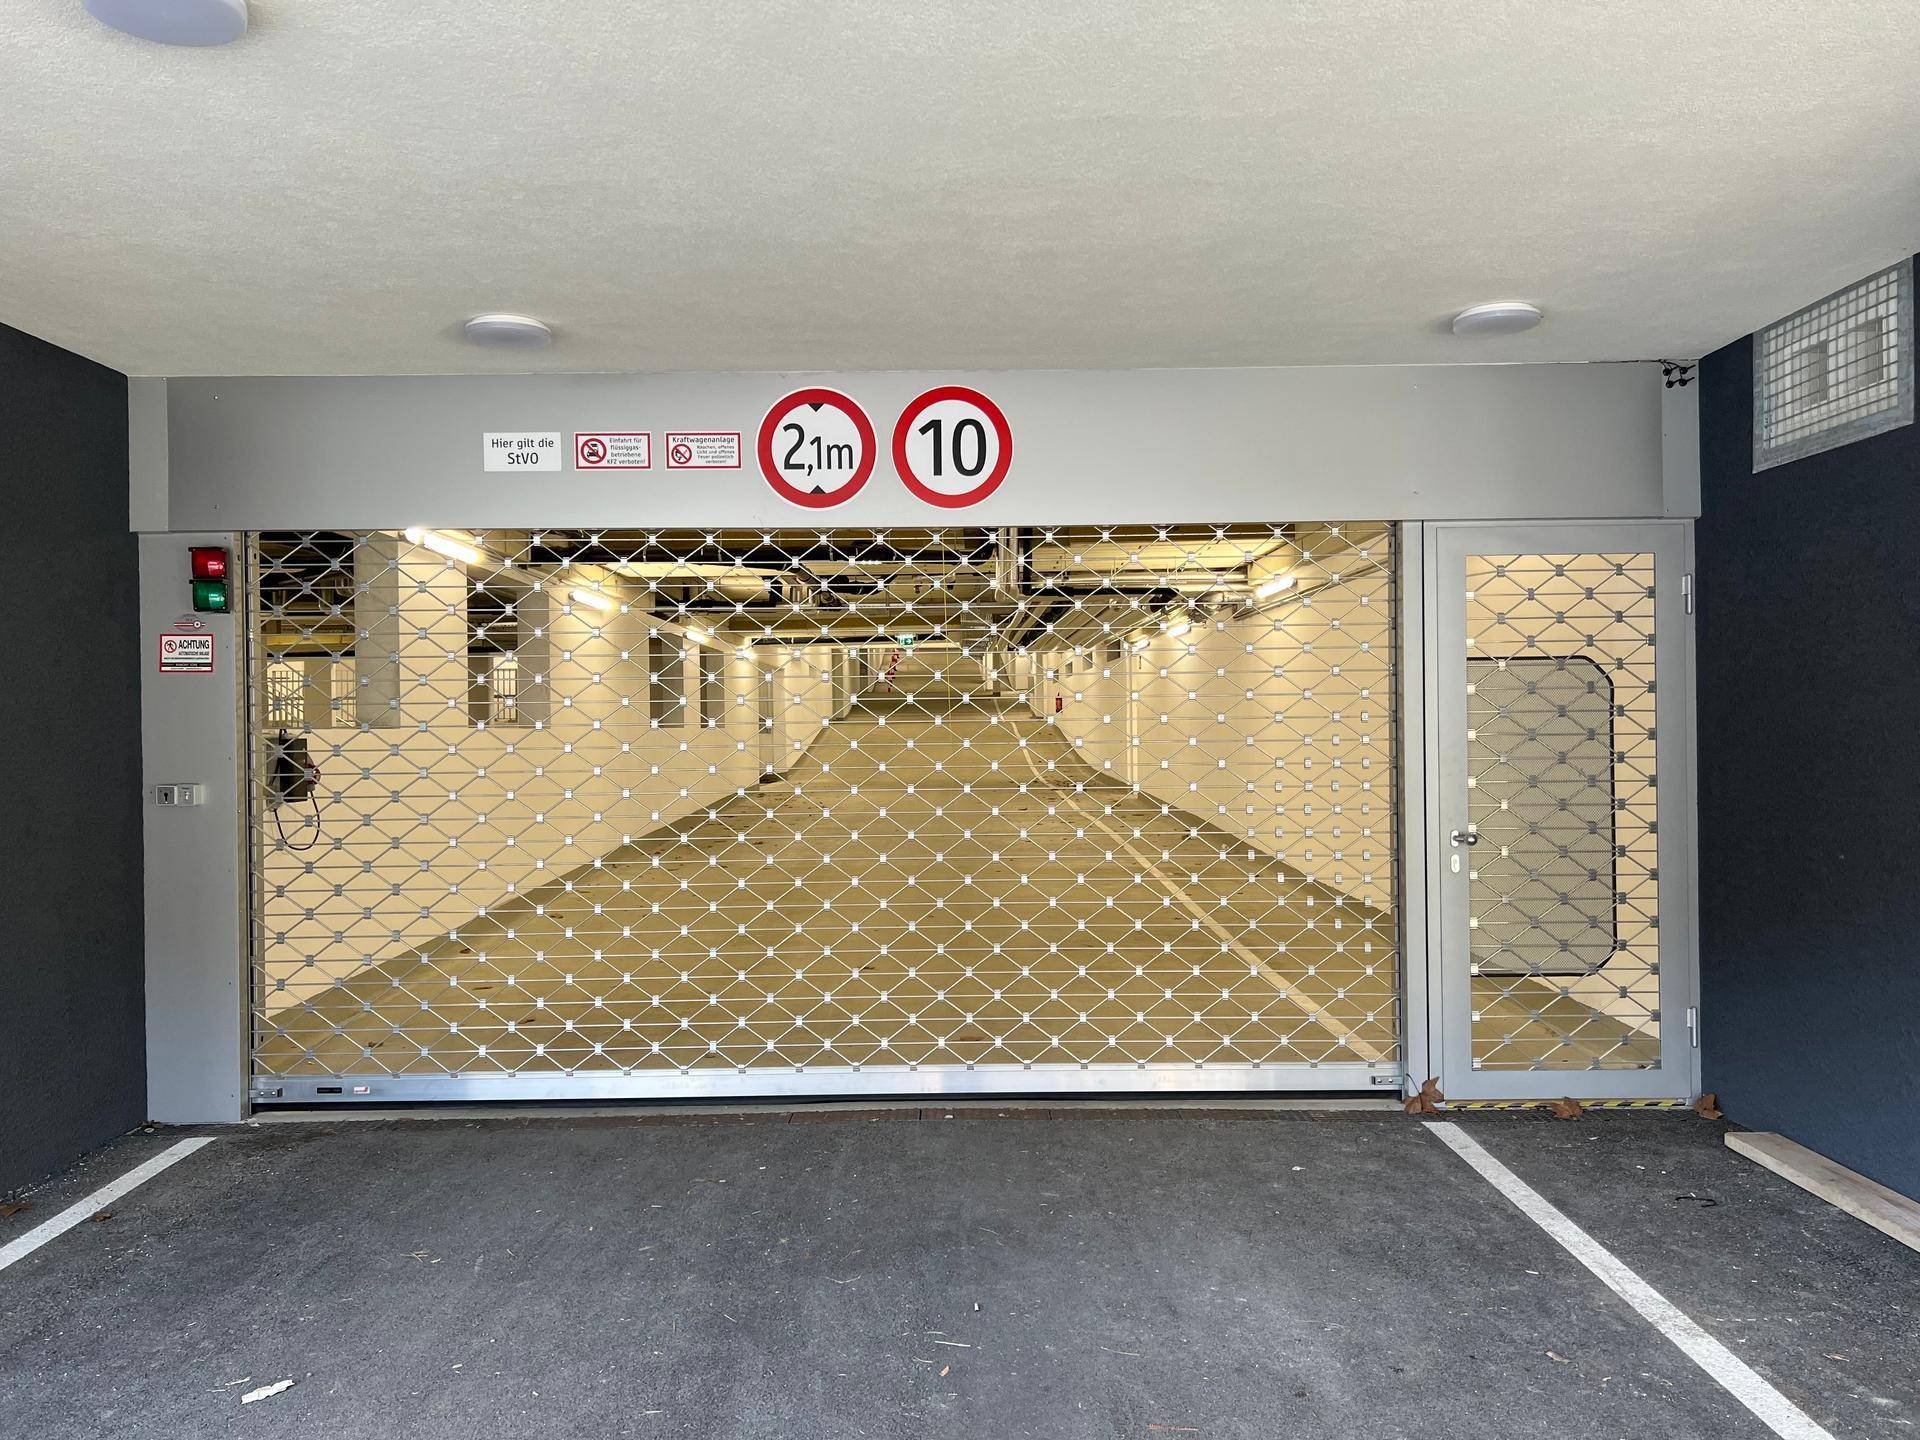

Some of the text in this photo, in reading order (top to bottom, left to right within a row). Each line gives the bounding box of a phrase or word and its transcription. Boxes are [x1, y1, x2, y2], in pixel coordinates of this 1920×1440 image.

[491, 437, 554, 450] Hier gilt die
[672, 436, 735, 444] Kraftwagenanlage
[782, 422, 854, 477] 2,1m
[917, 418, 987, 477] 10
[507, 452, 539, 465] StVO
[178, 639, 210, 649] ACHTUNG
